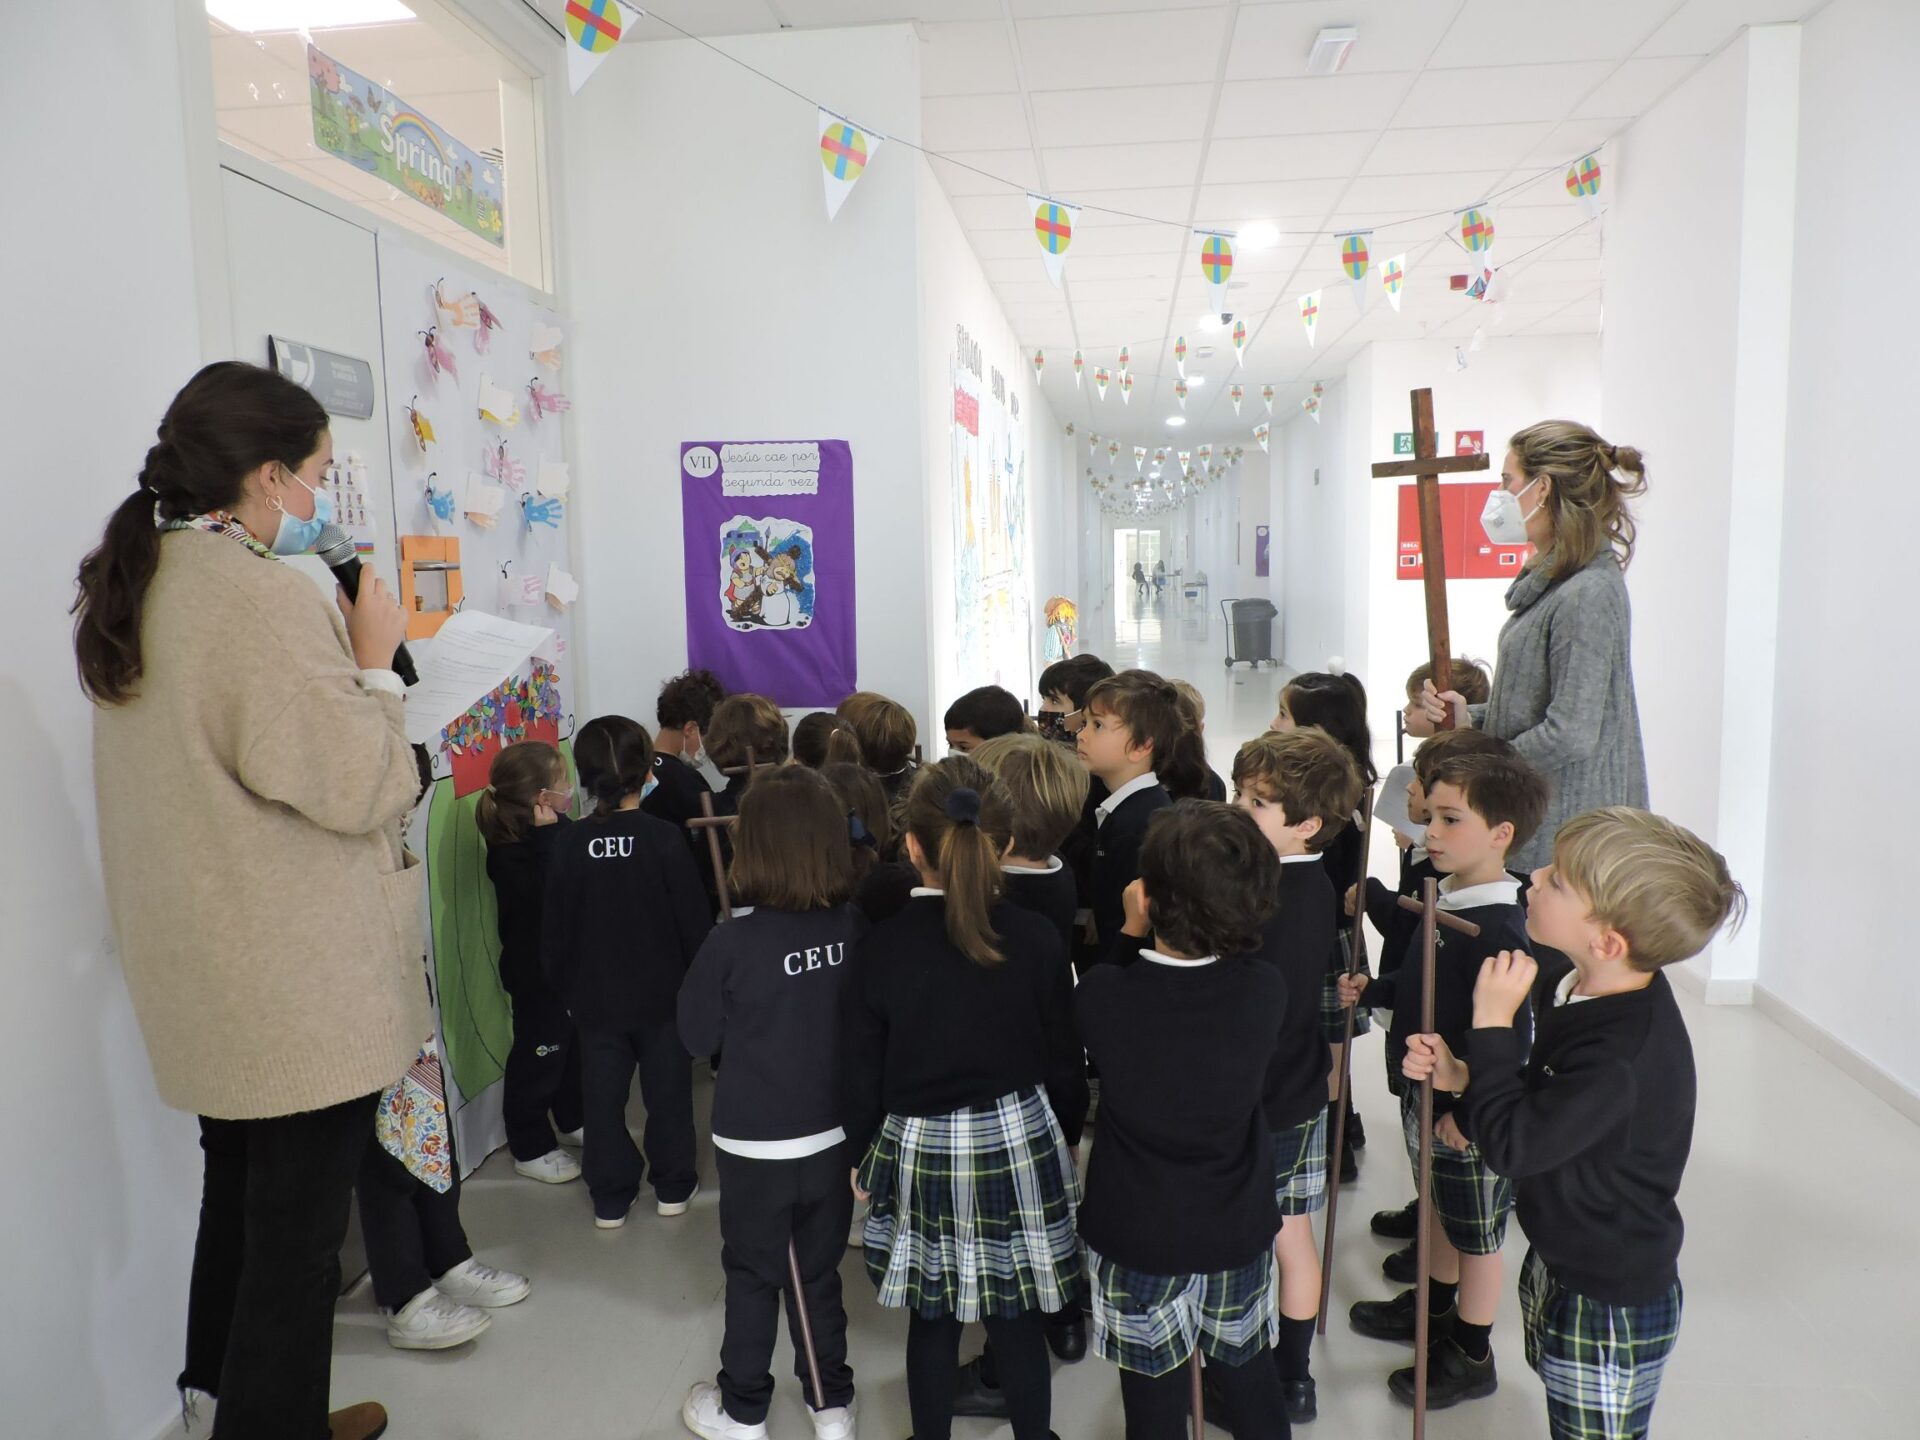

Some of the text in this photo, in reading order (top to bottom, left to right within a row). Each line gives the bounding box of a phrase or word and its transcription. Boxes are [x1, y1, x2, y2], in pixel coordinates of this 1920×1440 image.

[380, 113, 452, 202] Spring
[690, 456, 712, 469] VII
[724, 449, 818, 467] Jesús cae por
[725, 473, 815, 493] segunda vez
[588, 836, 635, 858] CEU
[784, 942, 844, 975] CEU
